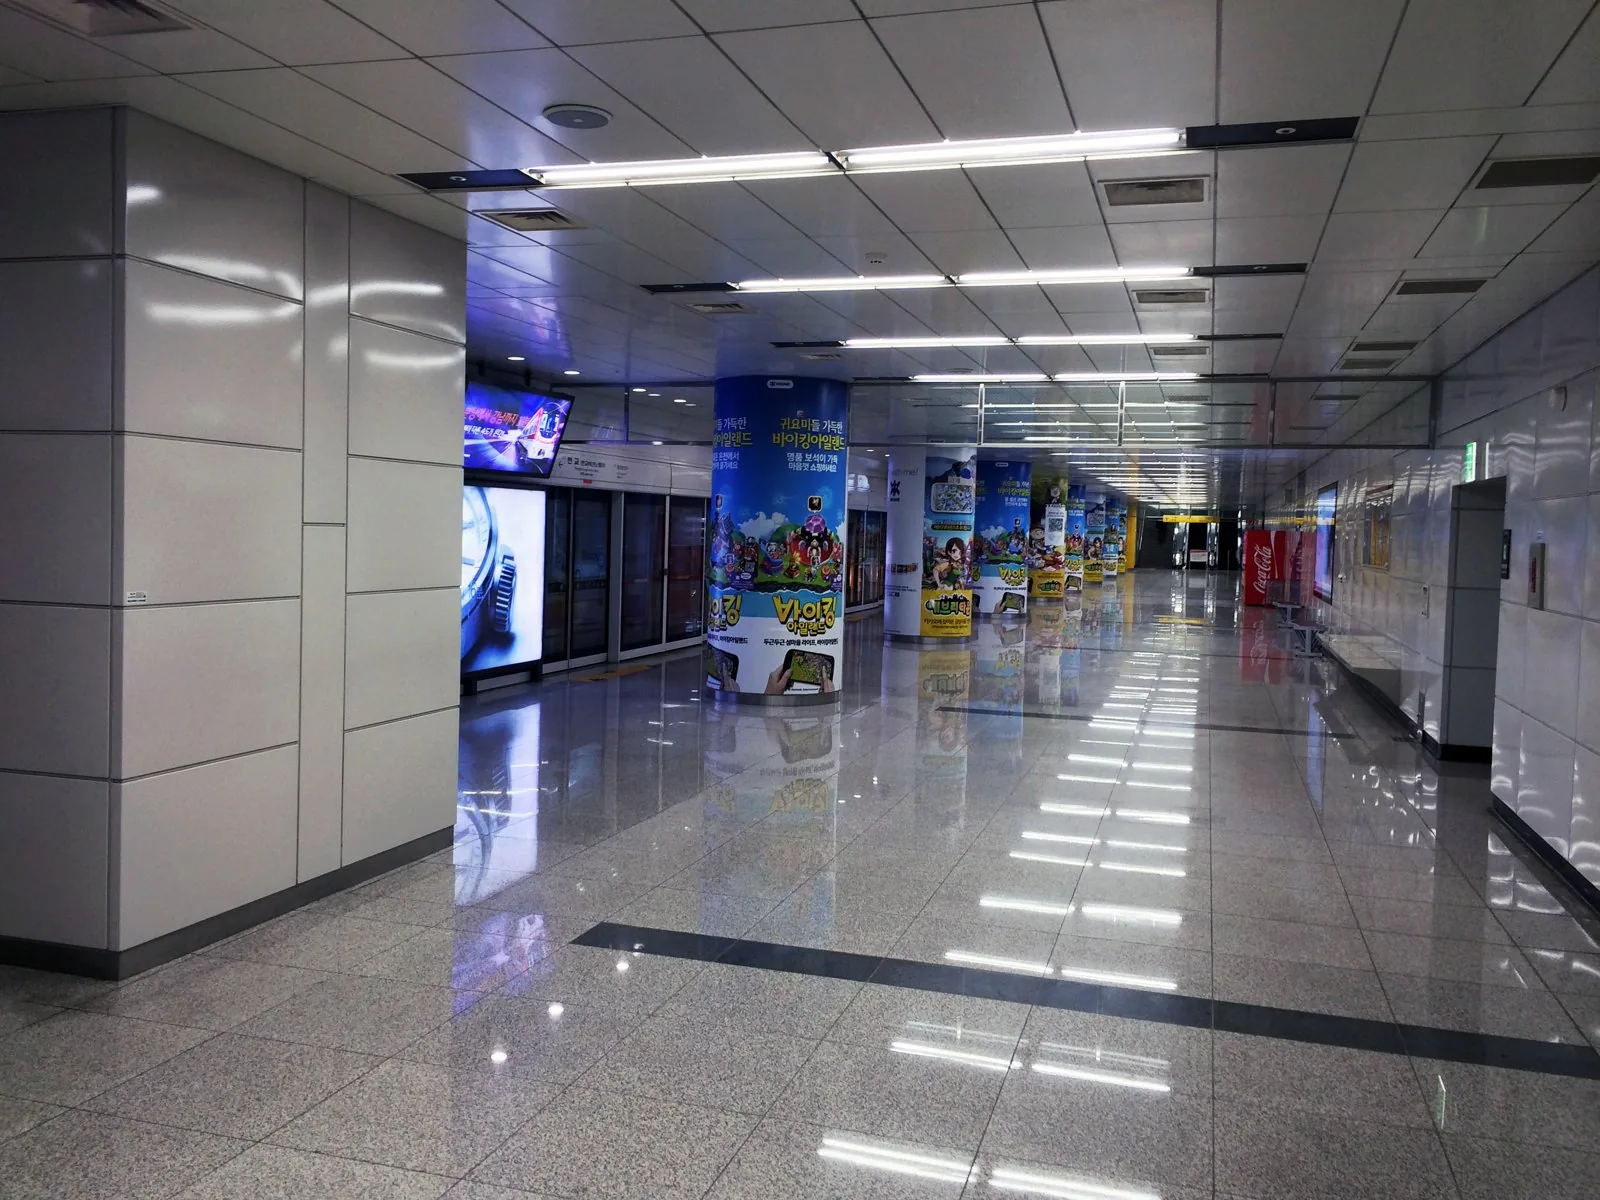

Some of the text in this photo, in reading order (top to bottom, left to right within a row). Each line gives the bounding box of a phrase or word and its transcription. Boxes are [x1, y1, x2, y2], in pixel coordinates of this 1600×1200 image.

[780, 417, 843, 434] 귀요미들 가득한
[772, 432, 845, 451] 바이킹아일랜드
[1253, 543, 1272, 594] Coca-Cola
[772, 594, 837, 629] 바이킹
[786, 621, 827, 637] 아일랜드
